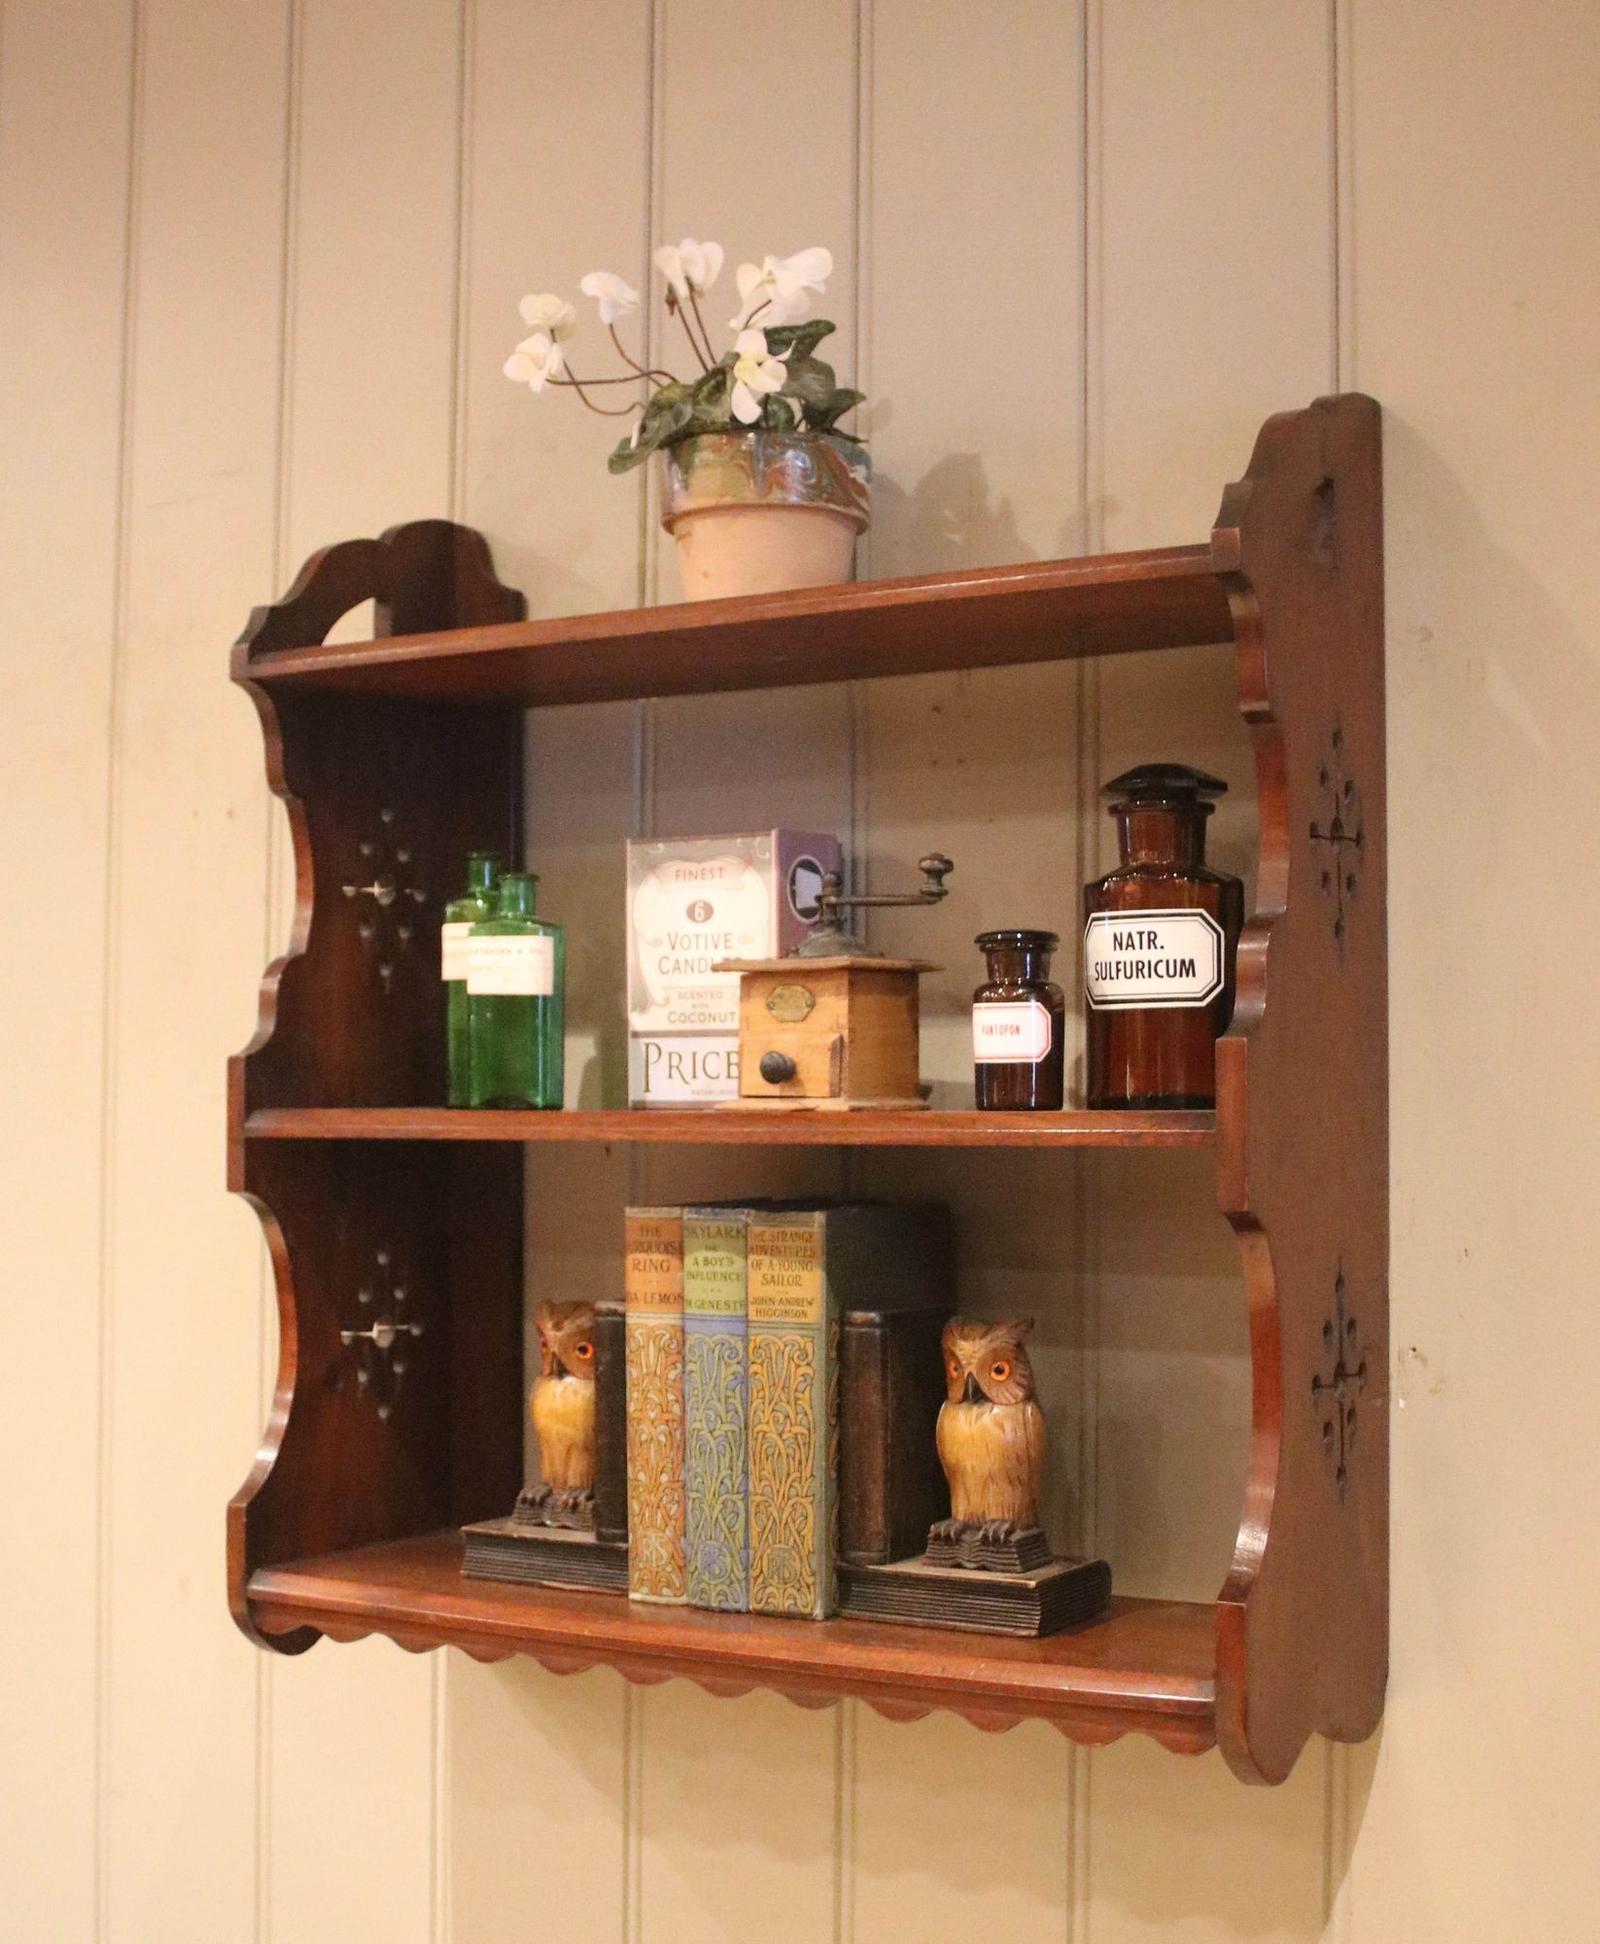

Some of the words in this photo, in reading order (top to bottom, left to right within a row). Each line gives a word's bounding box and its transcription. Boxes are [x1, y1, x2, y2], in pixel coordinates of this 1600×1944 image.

[674, 866, 725, 882] FINEST
[693, 902, 707, 922] 6
[667, 931, 734, 951] VOTIVE
[1112, 930, 1165, 952] NATR.
[658, 955, 744, 975] CAND
[1094, 957, 1197, 981] SULFURICUM
[667, 1010, 738, 1024] COCONUT
[768, 1230, 816, 1244] STRANGE
[632, 1258, 671, 1273] RING
[692, 1255, 700, 1267] A
[703, 1255, 735, 1267] BOY'S
[751, 1259, 764, 1272] OF
[777, 1259, 814, 1273] YOUNG
[686, 1270, 744, 1281] INFLUENCE
[760, 1273, 804, 1287] SAILOR
[750, 1296, 776, 1306] JOHN
[754, 1307, 808, 1319] HIGGINSON
